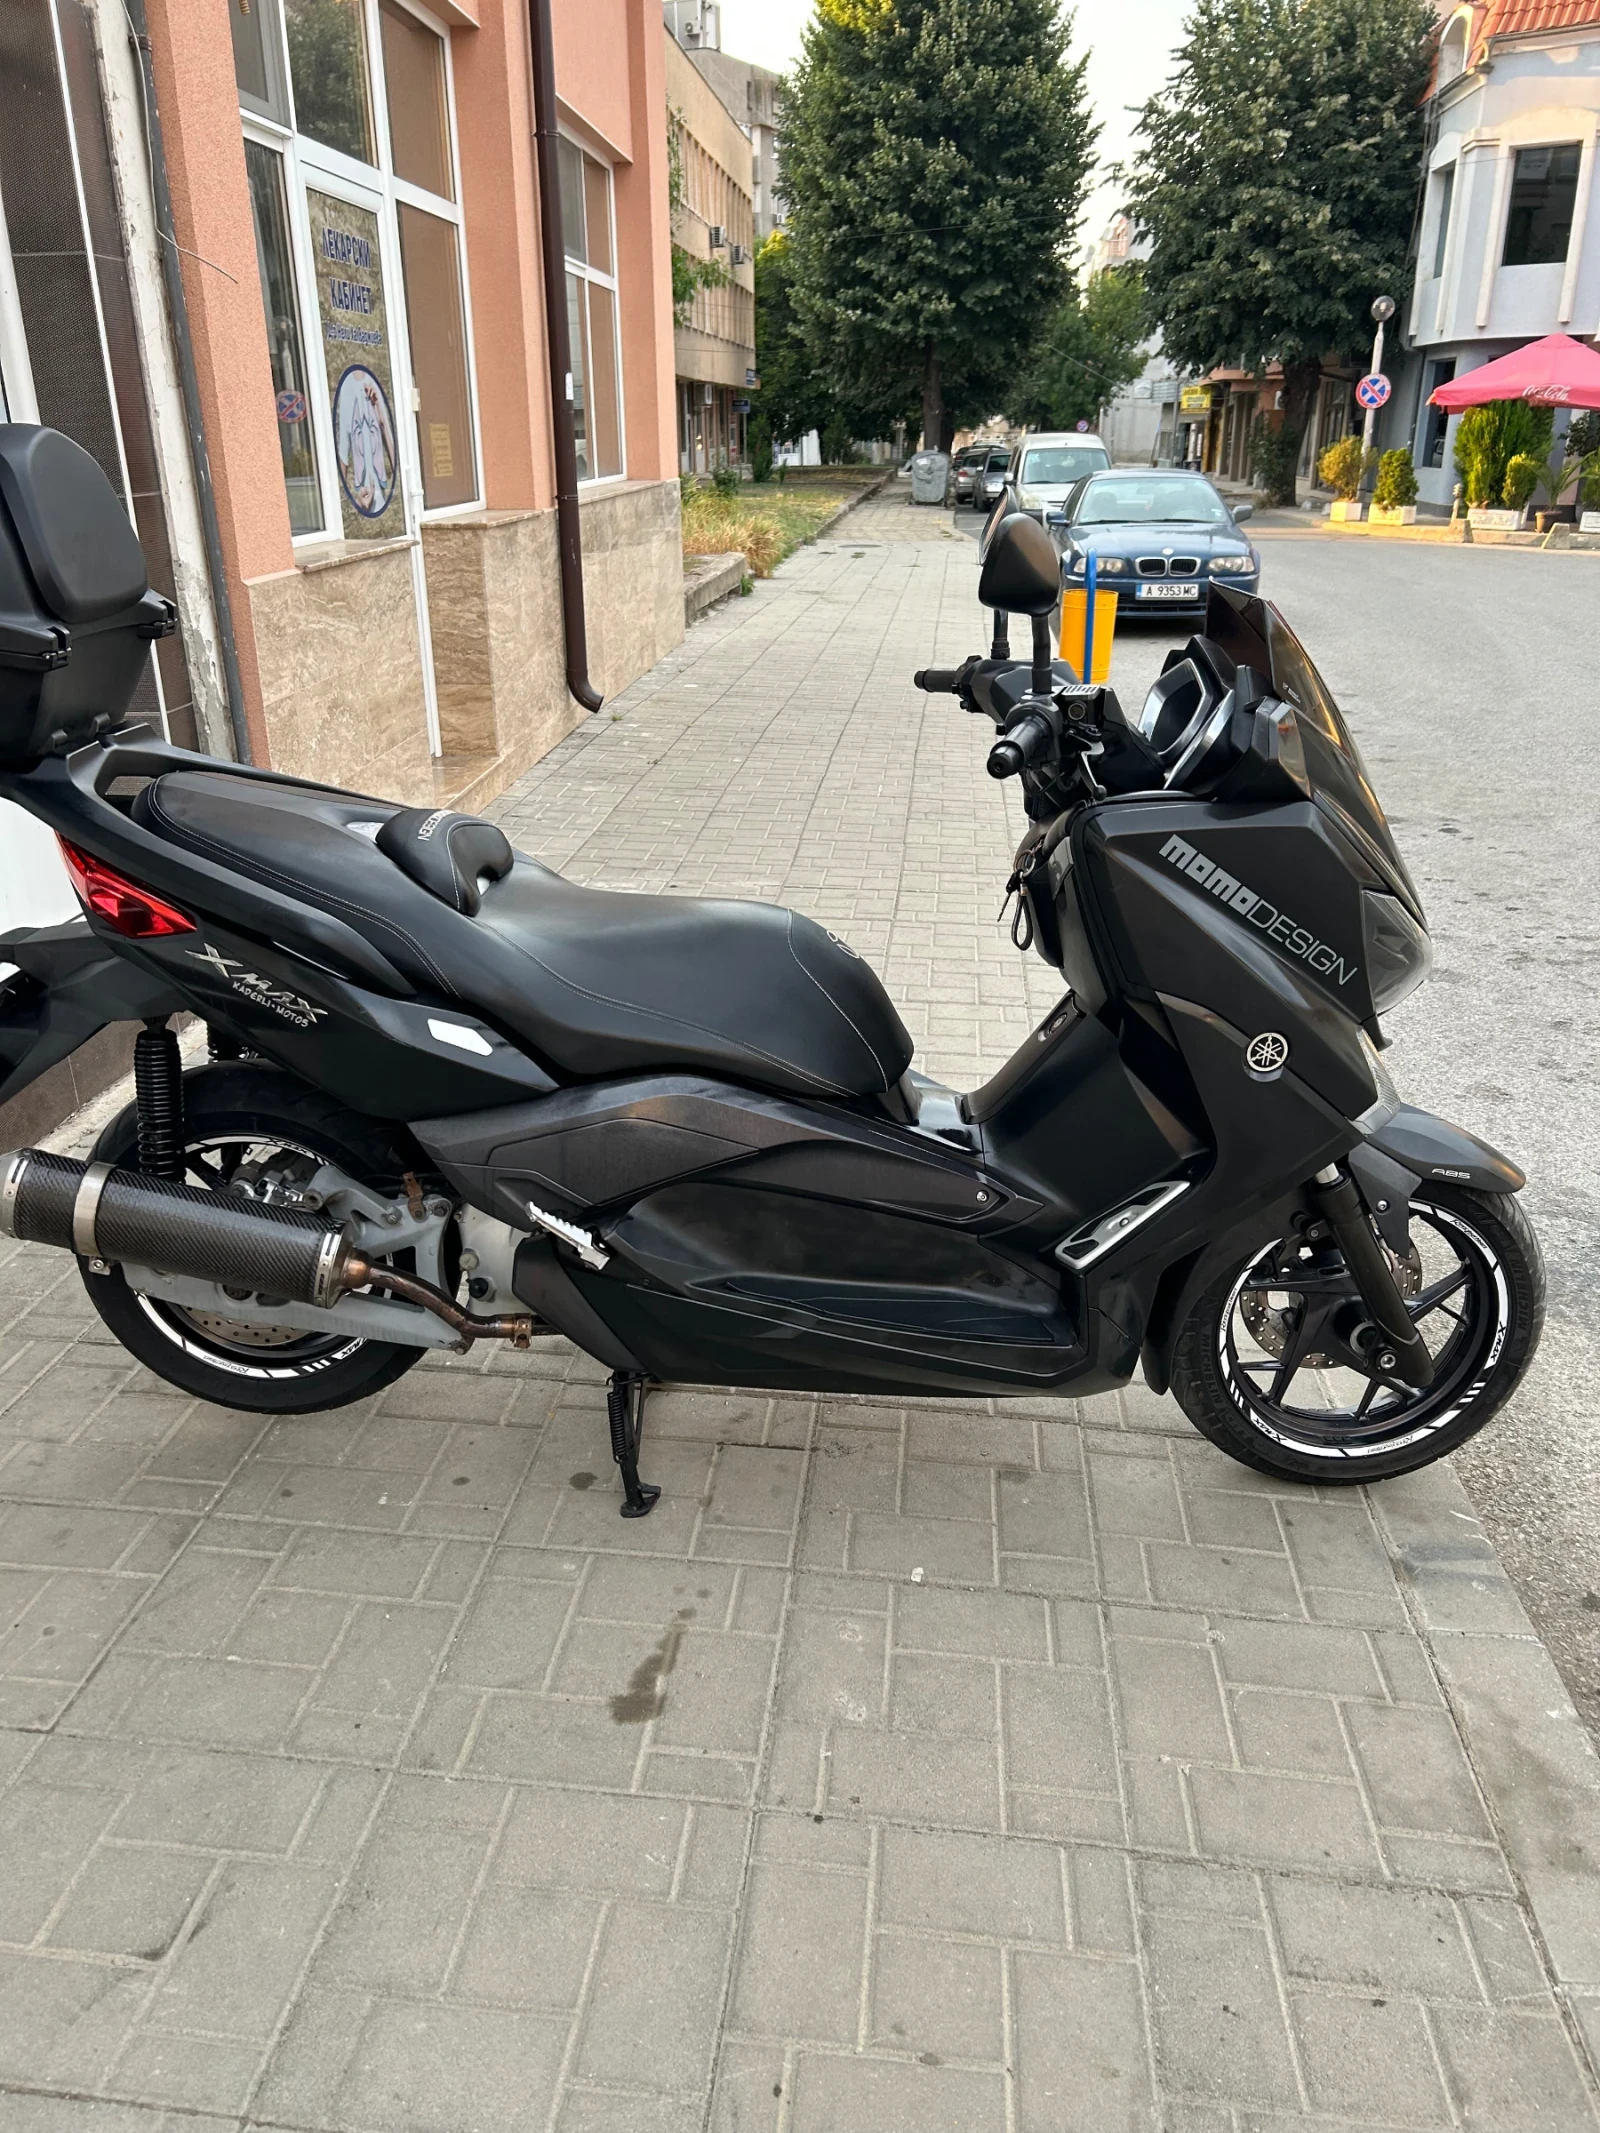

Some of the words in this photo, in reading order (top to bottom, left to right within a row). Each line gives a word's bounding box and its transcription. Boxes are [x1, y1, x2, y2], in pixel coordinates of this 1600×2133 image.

[322, 226, 371, 270] ЛЕКАРСКИ
[329, 277, 372, 315] КАБИНЕТ
[1146, 586, 1153, 596] A
[1157, 585, 1181, 597] 9353
[1183, 585, 1196, 597] MC
[1431, 1168, 1471, 1180] ABS
[1513, 1258, 1530, 1332] MICHELIN
[1202, 1333, 1223, 1404] MICHELIN
